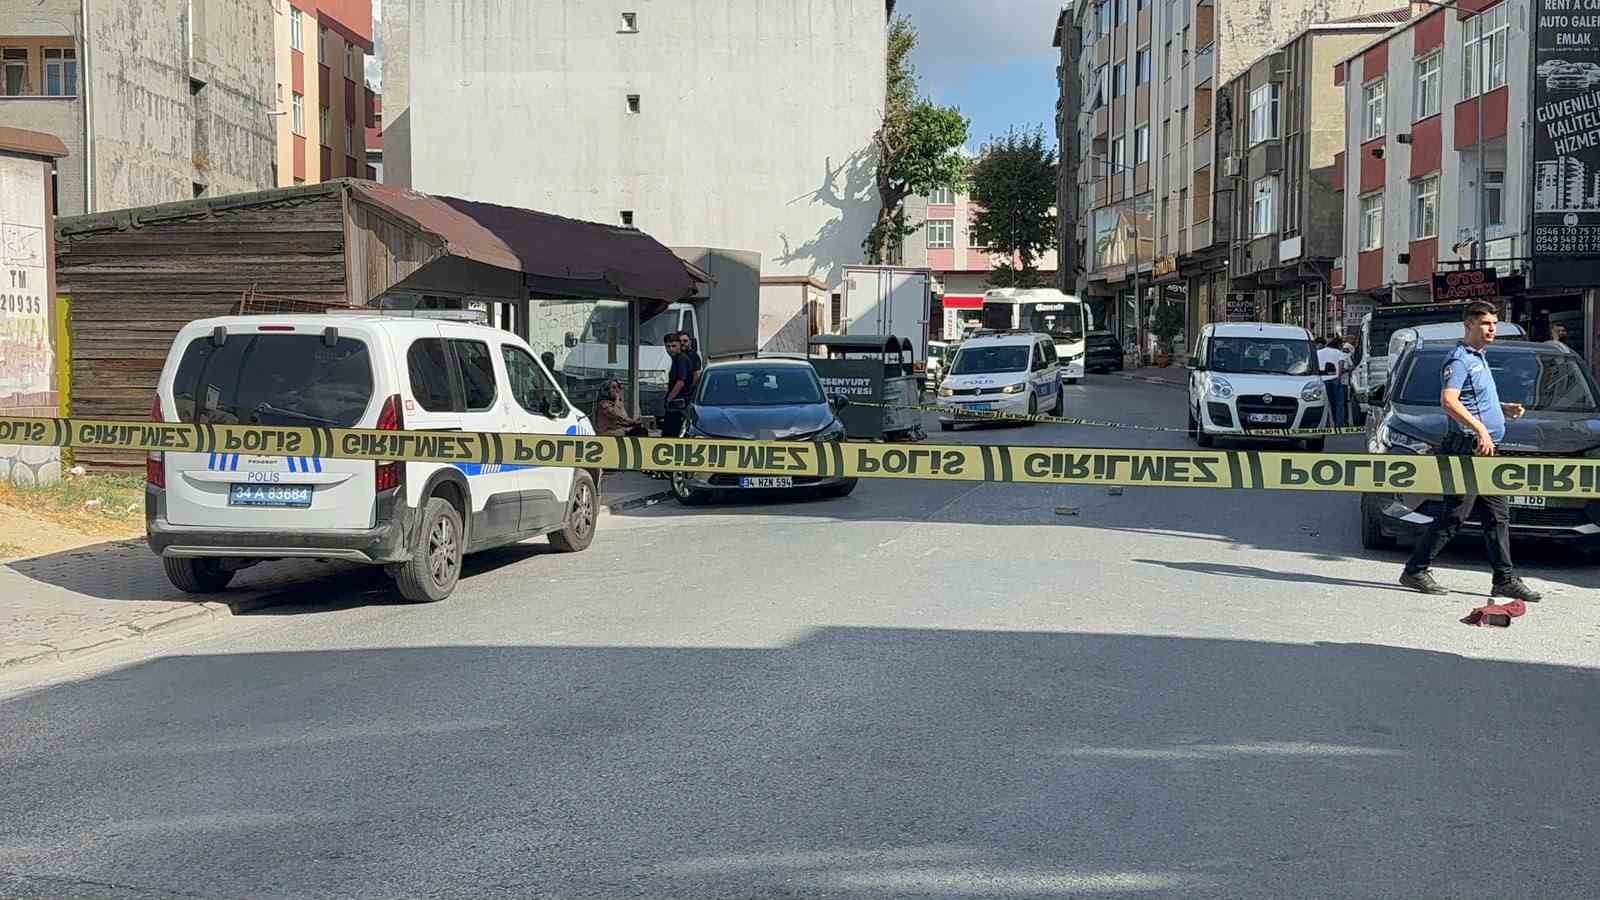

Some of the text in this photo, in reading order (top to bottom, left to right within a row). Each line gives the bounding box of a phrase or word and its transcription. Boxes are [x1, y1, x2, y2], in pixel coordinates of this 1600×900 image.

[1545, 0, 1570, 10] RENT
[1574, 0, 1580, 9] A
[1541, 16, 1568, 27] AUTO
[1557, 33, 1591, 45] EMLAK
[10, 270, 26, 288] TM
[1447, 271, 1484, 286] OTO
[0, 294, 40, 314] 20935
[236, 487, 250, 498] 34
[254, 487, 265, 499] A
